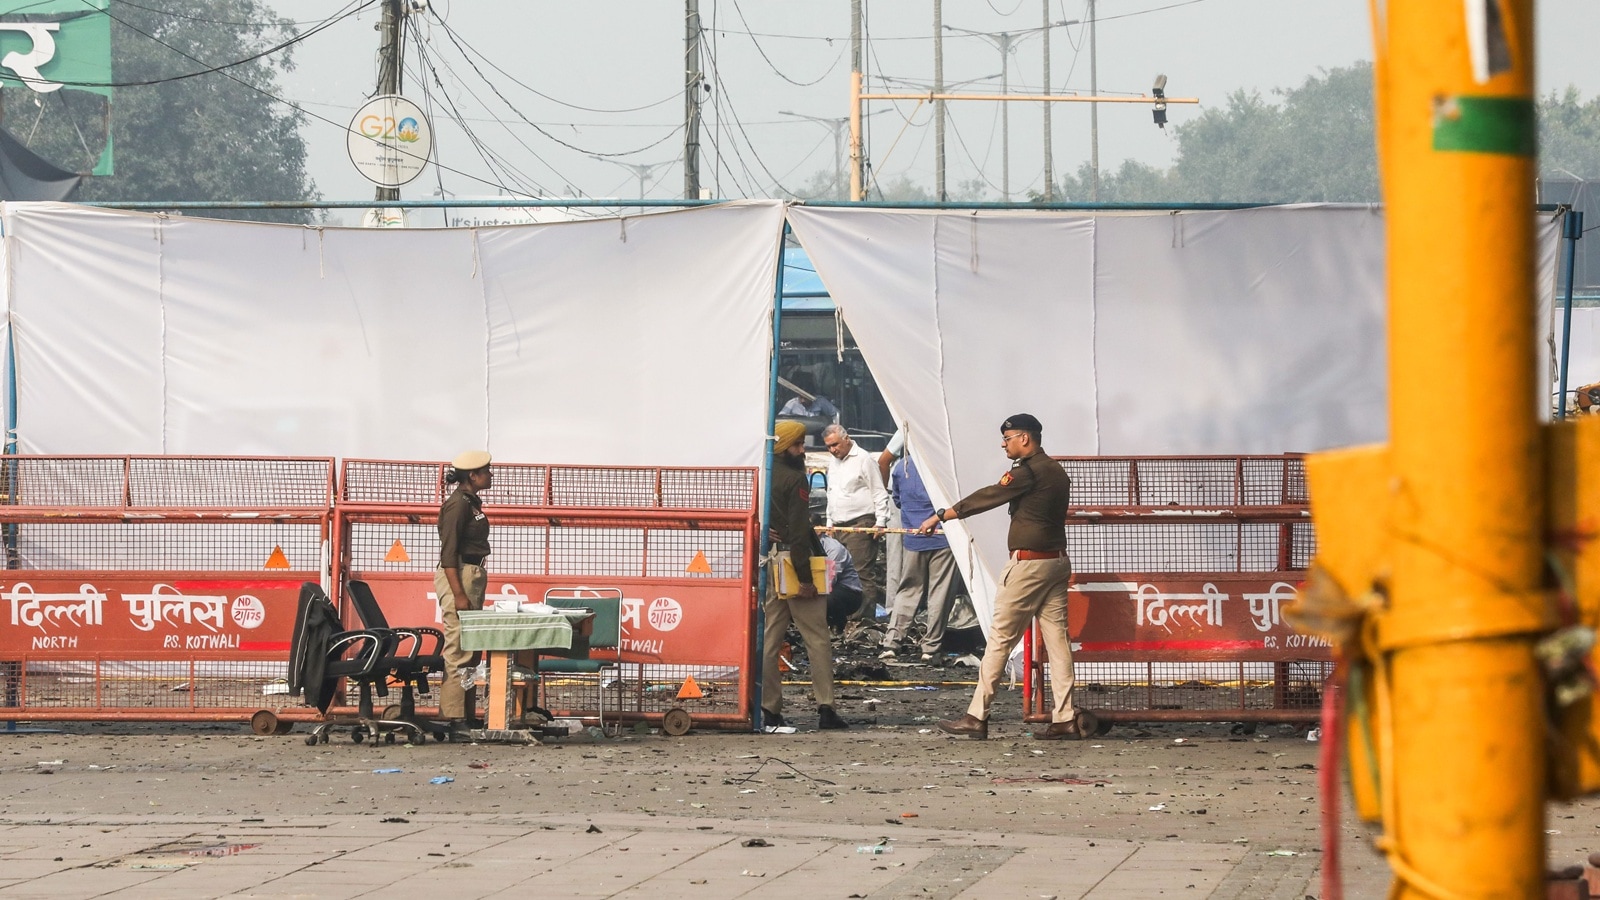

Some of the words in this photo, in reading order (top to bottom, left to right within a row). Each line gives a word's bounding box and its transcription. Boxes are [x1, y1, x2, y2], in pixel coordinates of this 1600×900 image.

[0, 22, 64, 93] र
[360, 115, 420, 143] G20
[1, 582, 108, 634] दिल्ली
[120, 583, 228, 633] पुलिस
[655, 599, 669, 607] ND
[1129, 582, 1229, 634] दिल्ली
[32, 635, 78, 650] NORTH
[186, 633, 240, 649] KOTWALI
[607, 638, 663, 653] TWALI
[1286, 634, 1334, 648] KOTWAL
